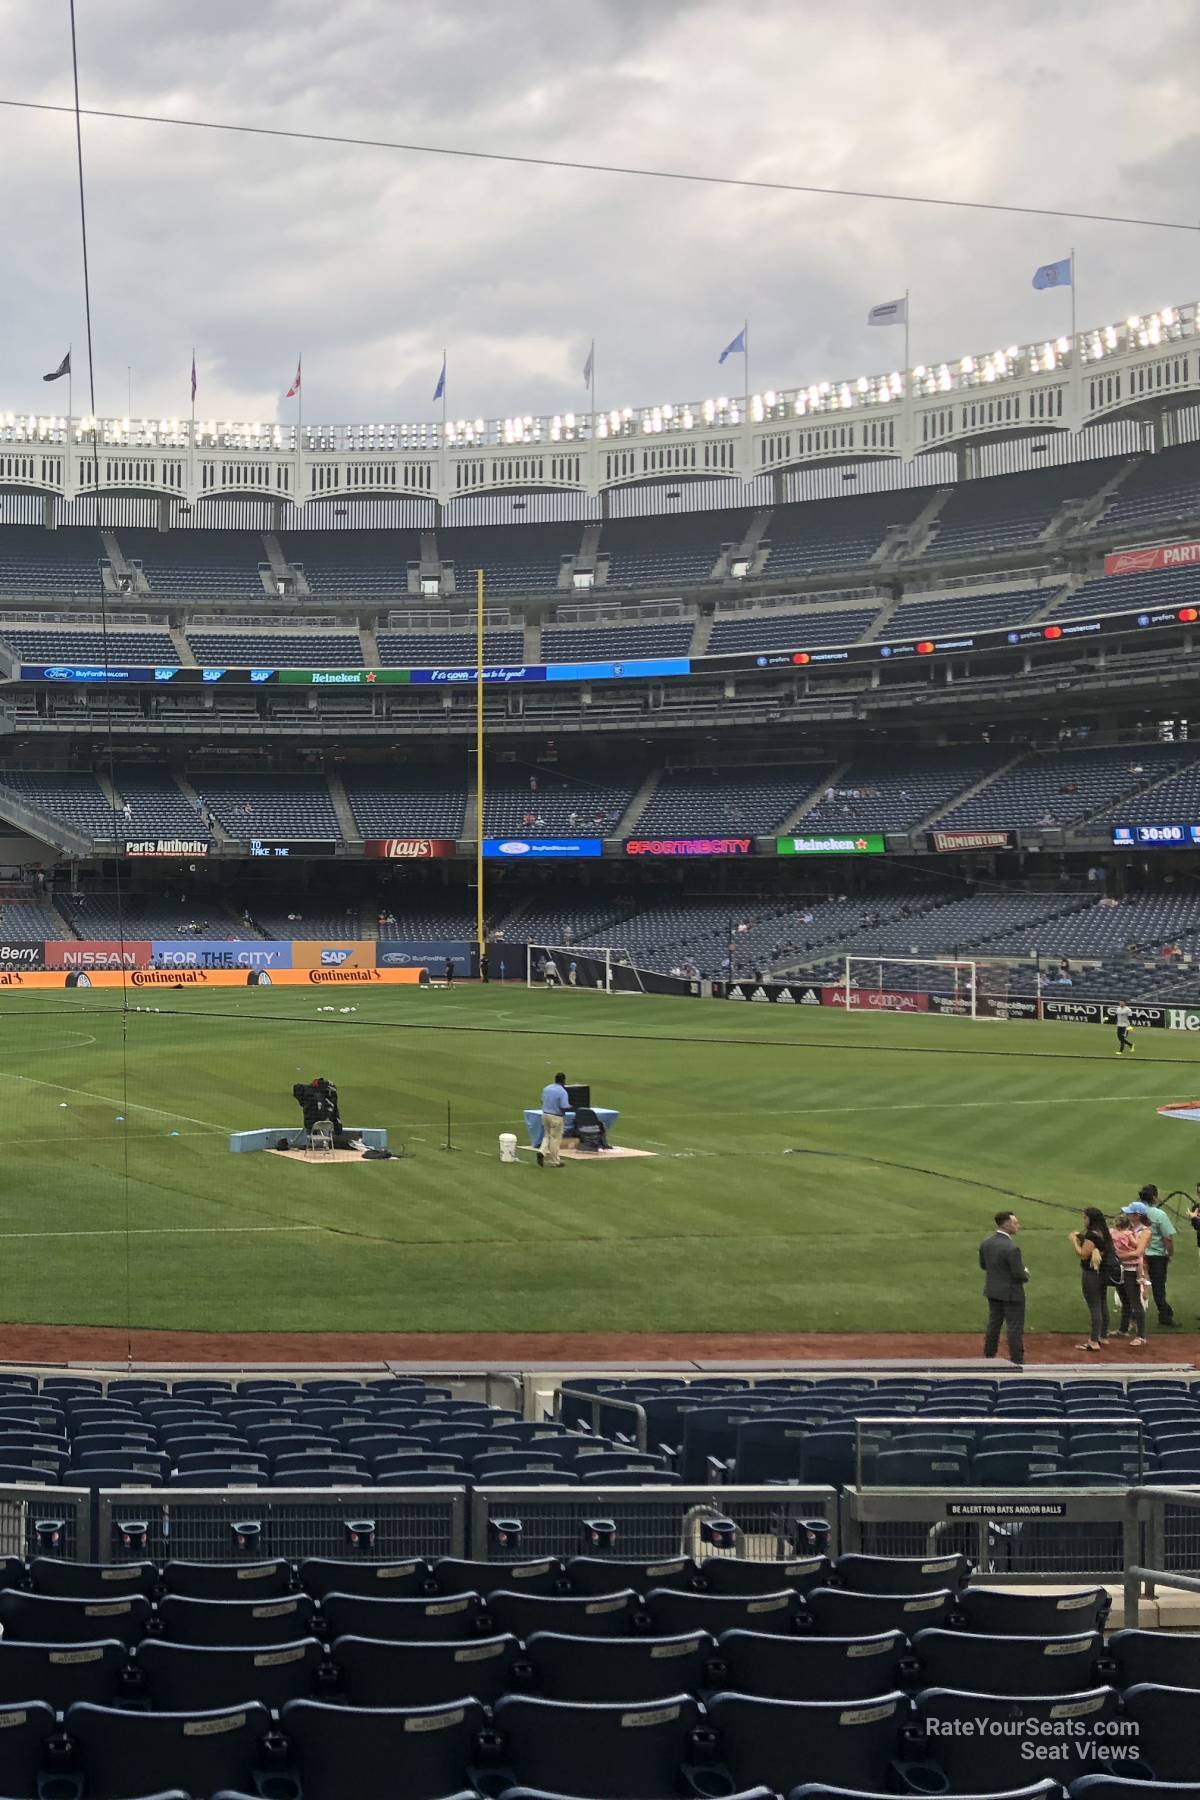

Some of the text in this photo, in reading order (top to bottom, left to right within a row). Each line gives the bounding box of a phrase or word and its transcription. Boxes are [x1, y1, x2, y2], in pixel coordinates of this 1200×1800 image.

[1163, 545, 1200, 564] PART
[1063, 623, 1100, 633] mastercard
[811, 652, 848, 660] mastercard
[155, 671, 173, 680] SAP
[203, 672, 221, 680] SAP
[250, 672, 269, 681] SAP
[312, 672, 361, 683] Heineken
[1141, 827, 1181, 840] 30:00
[126, 839, 208, 854] Parts Authority
[389, 839, 429, 857] Lay's
[626, 840, 751, 854] #FORTHECITY
[793, 839, 856, 851] Heineken
[251, 848, 289, 856] TAKE THE
[63, 952, 136, 964] NISSAN
[163, 951, 275, 964] FOR THE CITY
[320, 951, 347, 964] SAP
[131, 970, 197, 985] Continental
[309, 969, 372, 984] Continental
[832, 991, 860, 1004] Audi
[1047, 1003, 1097, 1014] ETIHAD
[1056, 1014, 1088, 1022] AIRWAYS
[952, 1505, 1062, 1514] BE ALERT FOR BATS AND/OR BALLS
